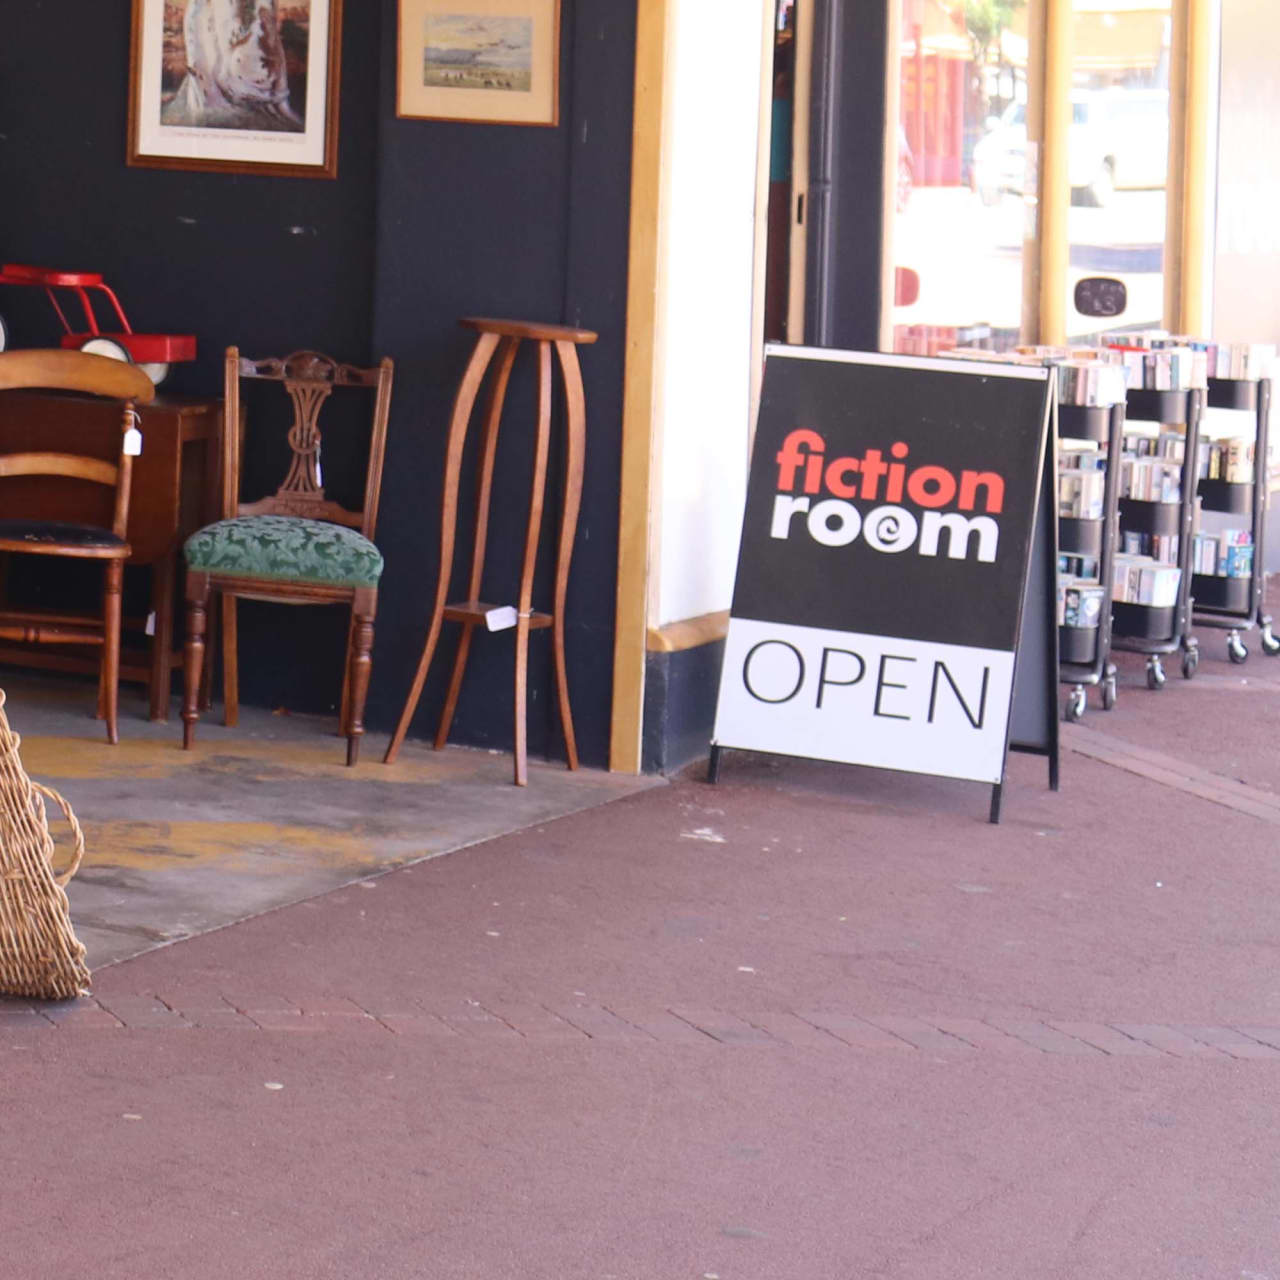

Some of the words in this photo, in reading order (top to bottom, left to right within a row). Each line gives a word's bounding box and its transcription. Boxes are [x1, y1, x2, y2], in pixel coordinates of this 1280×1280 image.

[775, 427, 1006, 514] fiction
[769, 493, 1000, 563] room
[741, 638, 991, 730] OPEN
